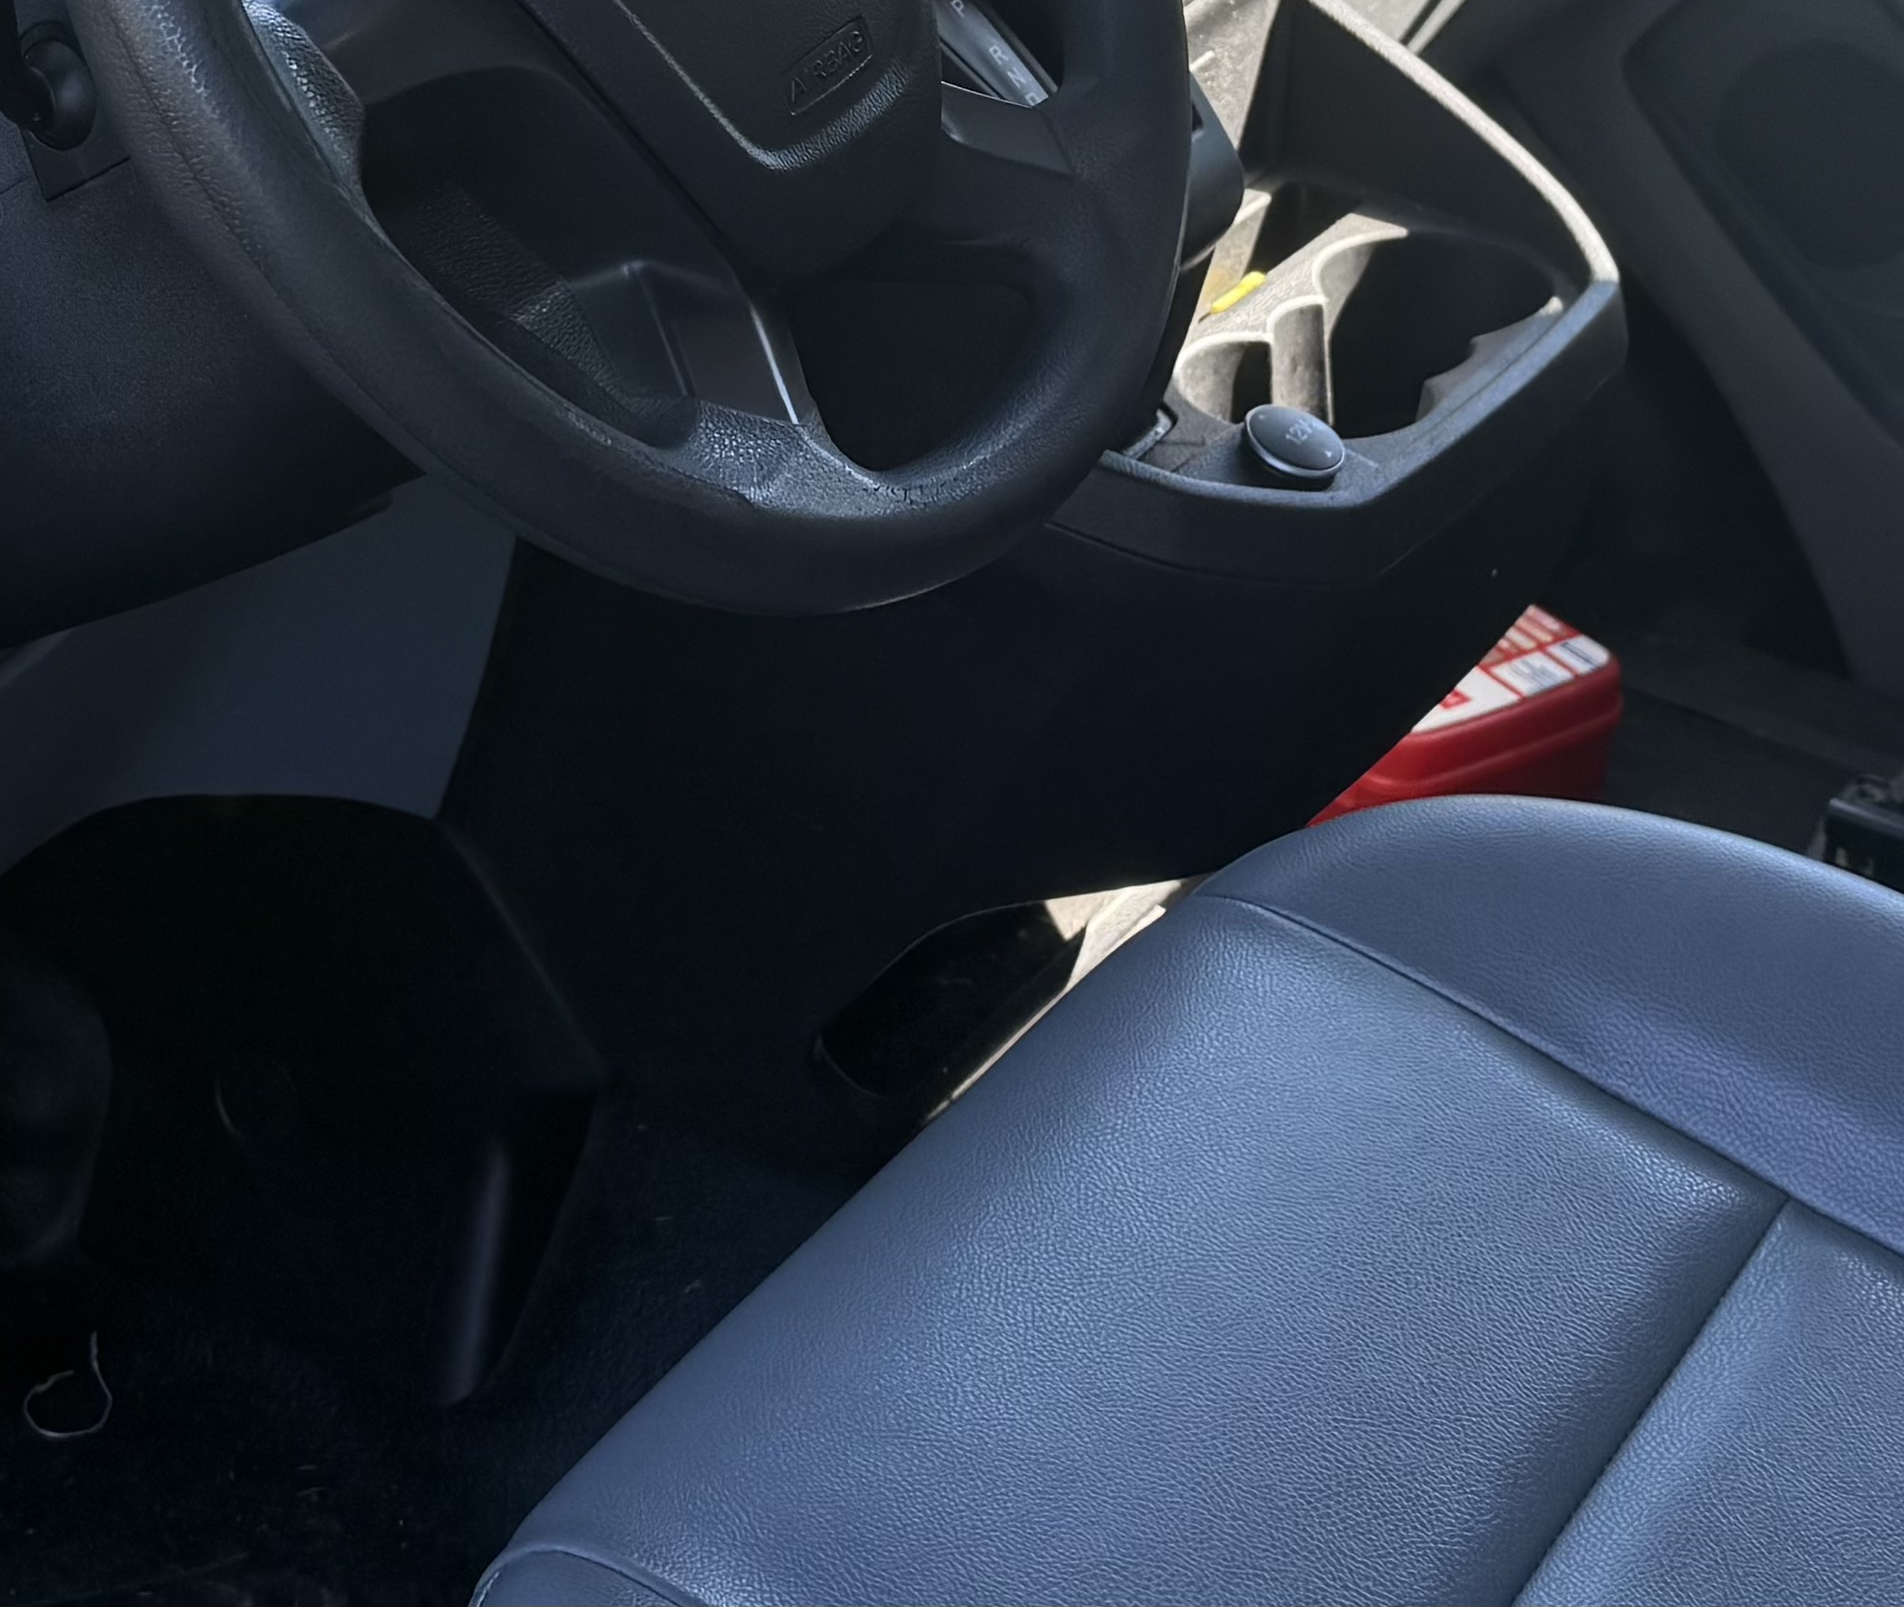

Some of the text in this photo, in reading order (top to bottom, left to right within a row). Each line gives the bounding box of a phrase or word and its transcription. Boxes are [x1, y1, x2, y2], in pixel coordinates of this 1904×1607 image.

[989, 45, 1009, 65] R
[1007, 67, 1027, 89] N
[1284, 418, 1314, 445] 12V
